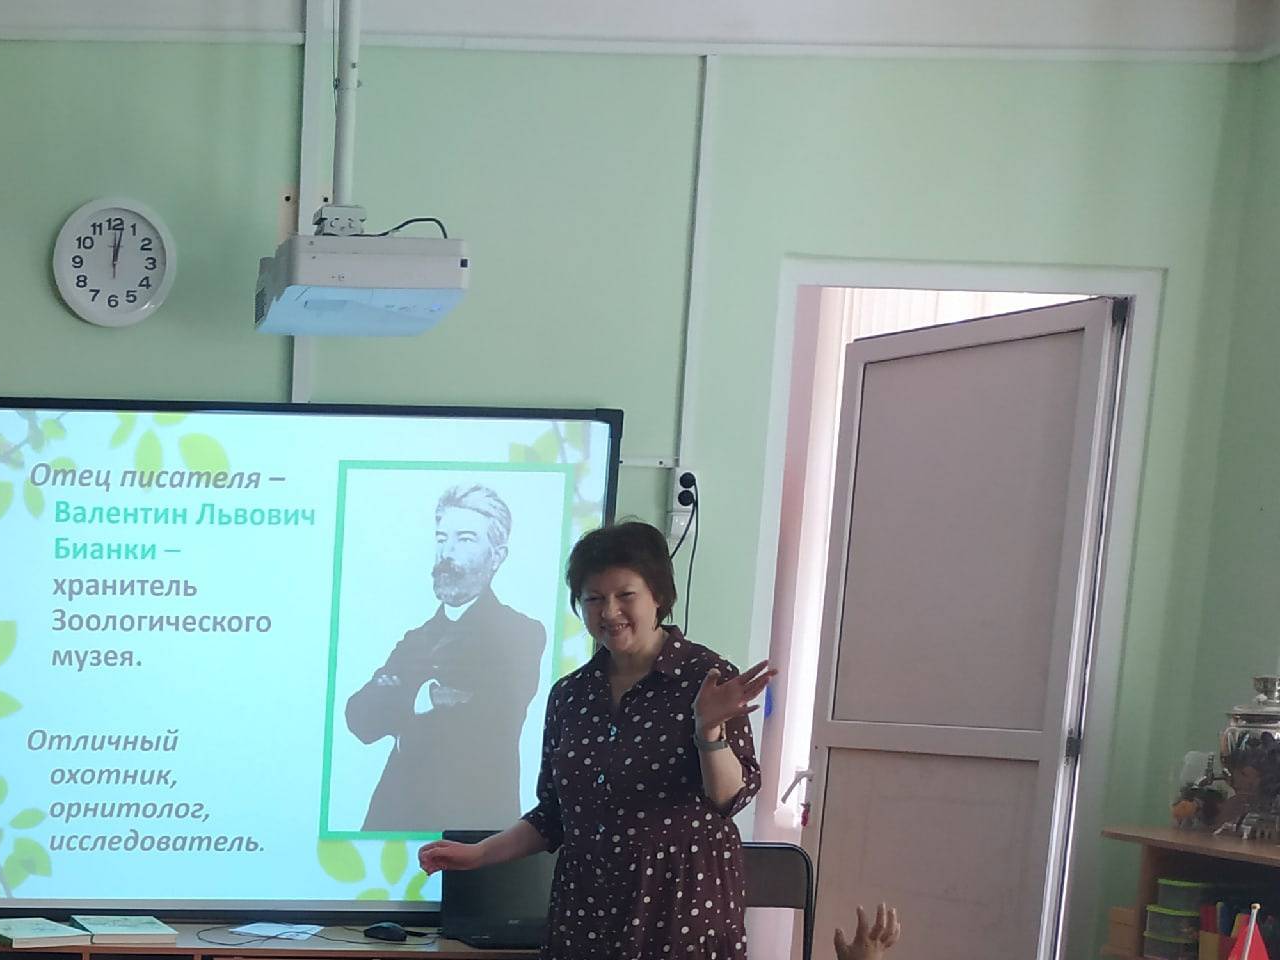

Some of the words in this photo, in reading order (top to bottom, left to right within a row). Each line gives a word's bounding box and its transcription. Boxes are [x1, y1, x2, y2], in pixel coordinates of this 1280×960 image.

[90, 223, 103, 235] 11
[106, 217, 124, 231] 12
[130, 223, 137, 236] 1
[76, 236, 94, 250] 10
[140, 238, 153, 251] 2
[71, 255, 84, 269] 9
[144, 257, 157, 270] 3
[76, 275, 88, 288] 8
[138, 276, 151, 289] 4
[89, 289, 100, 302] 7
[107, 295, 119, 308] 6
[125, 290, 137, 303] 5
[29, 462, 111, 492] Отец
[119, 469, 262, 489] писателя
[54, 500, 188, 526] Валентин
[195, 502, 316, 527] Львович
[53, 536, 158, 561] Бианки
[51, 578, 199, 602] хранитель
[51, 608, 273, 634] Зоологического
[51, 648, 143, 672] музея.
[26, 728, 179, 753] Отличный
[50, 767, 178, 790] охотник,
[49, 801, 211, 824] орнитолог,
[49, 829, 265, 854] исследователь.
